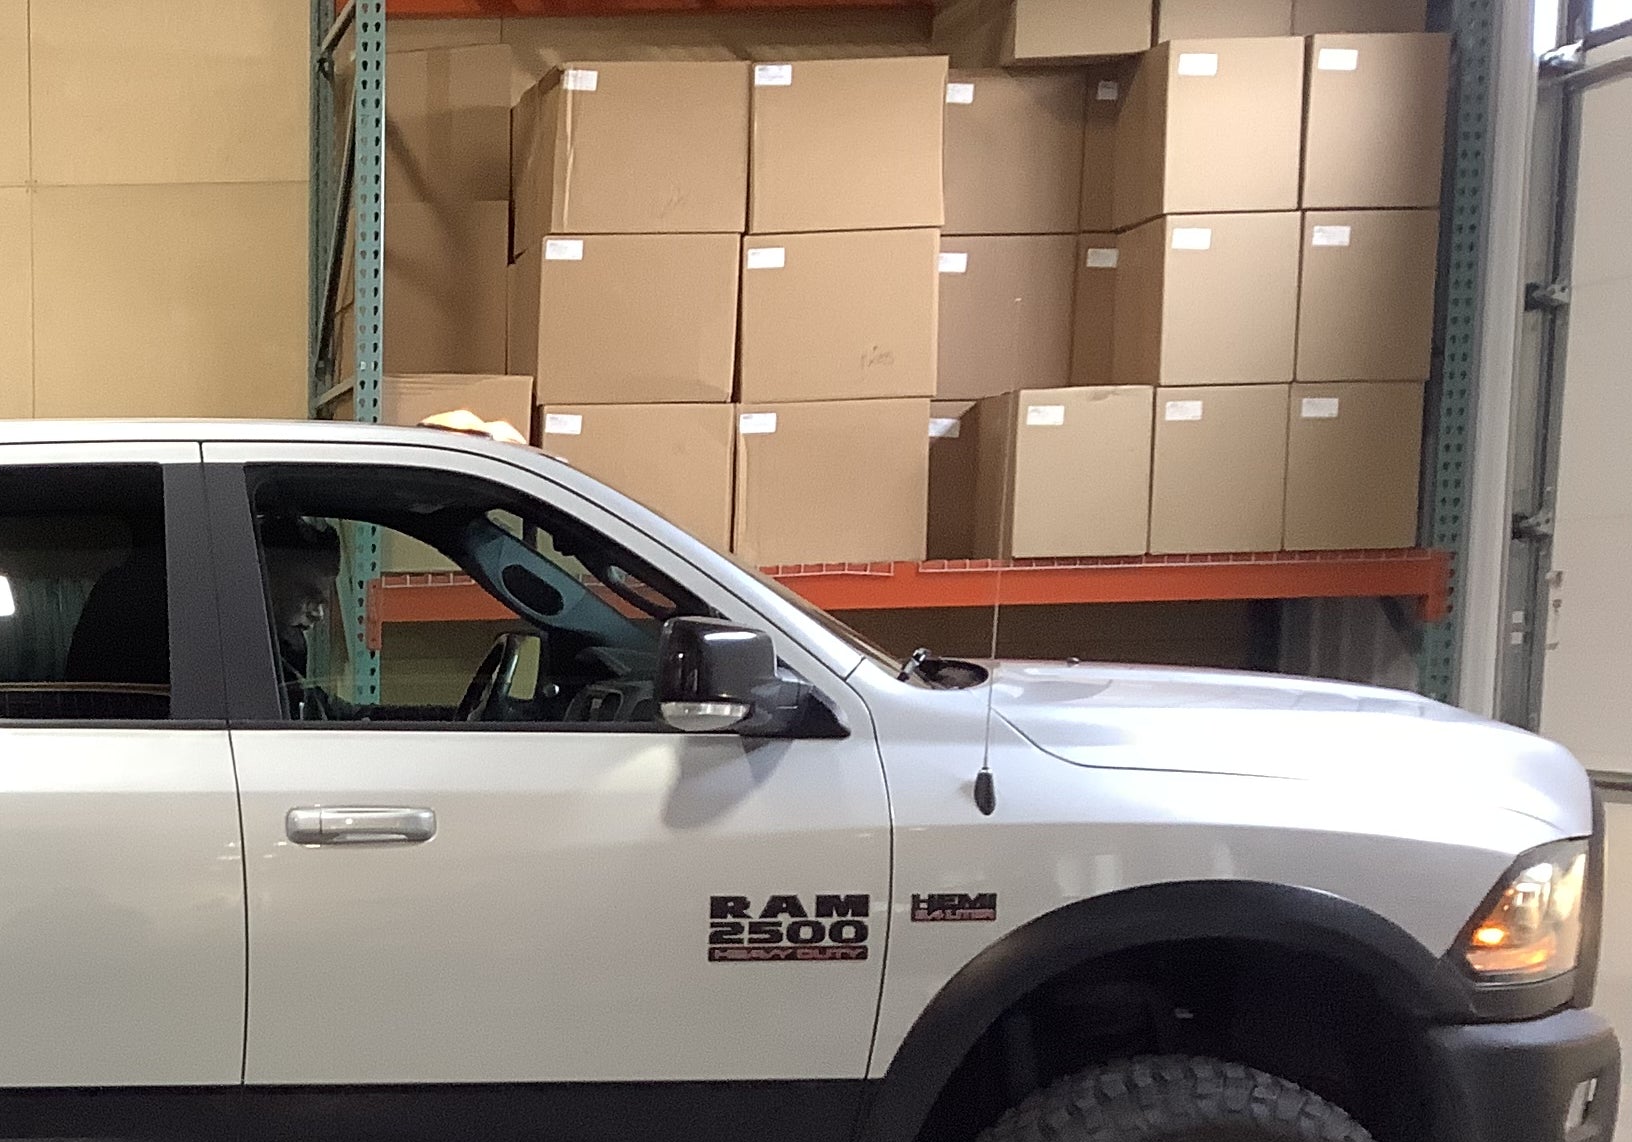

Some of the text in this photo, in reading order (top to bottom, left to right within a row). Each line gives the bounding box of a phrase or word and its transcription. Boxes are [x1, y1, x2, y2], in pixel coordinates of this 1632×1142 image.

[709, 894, 870, 919] RAM
[708, 920, 869, 945] 2500
[796, 947, 865, 958] DUTY
